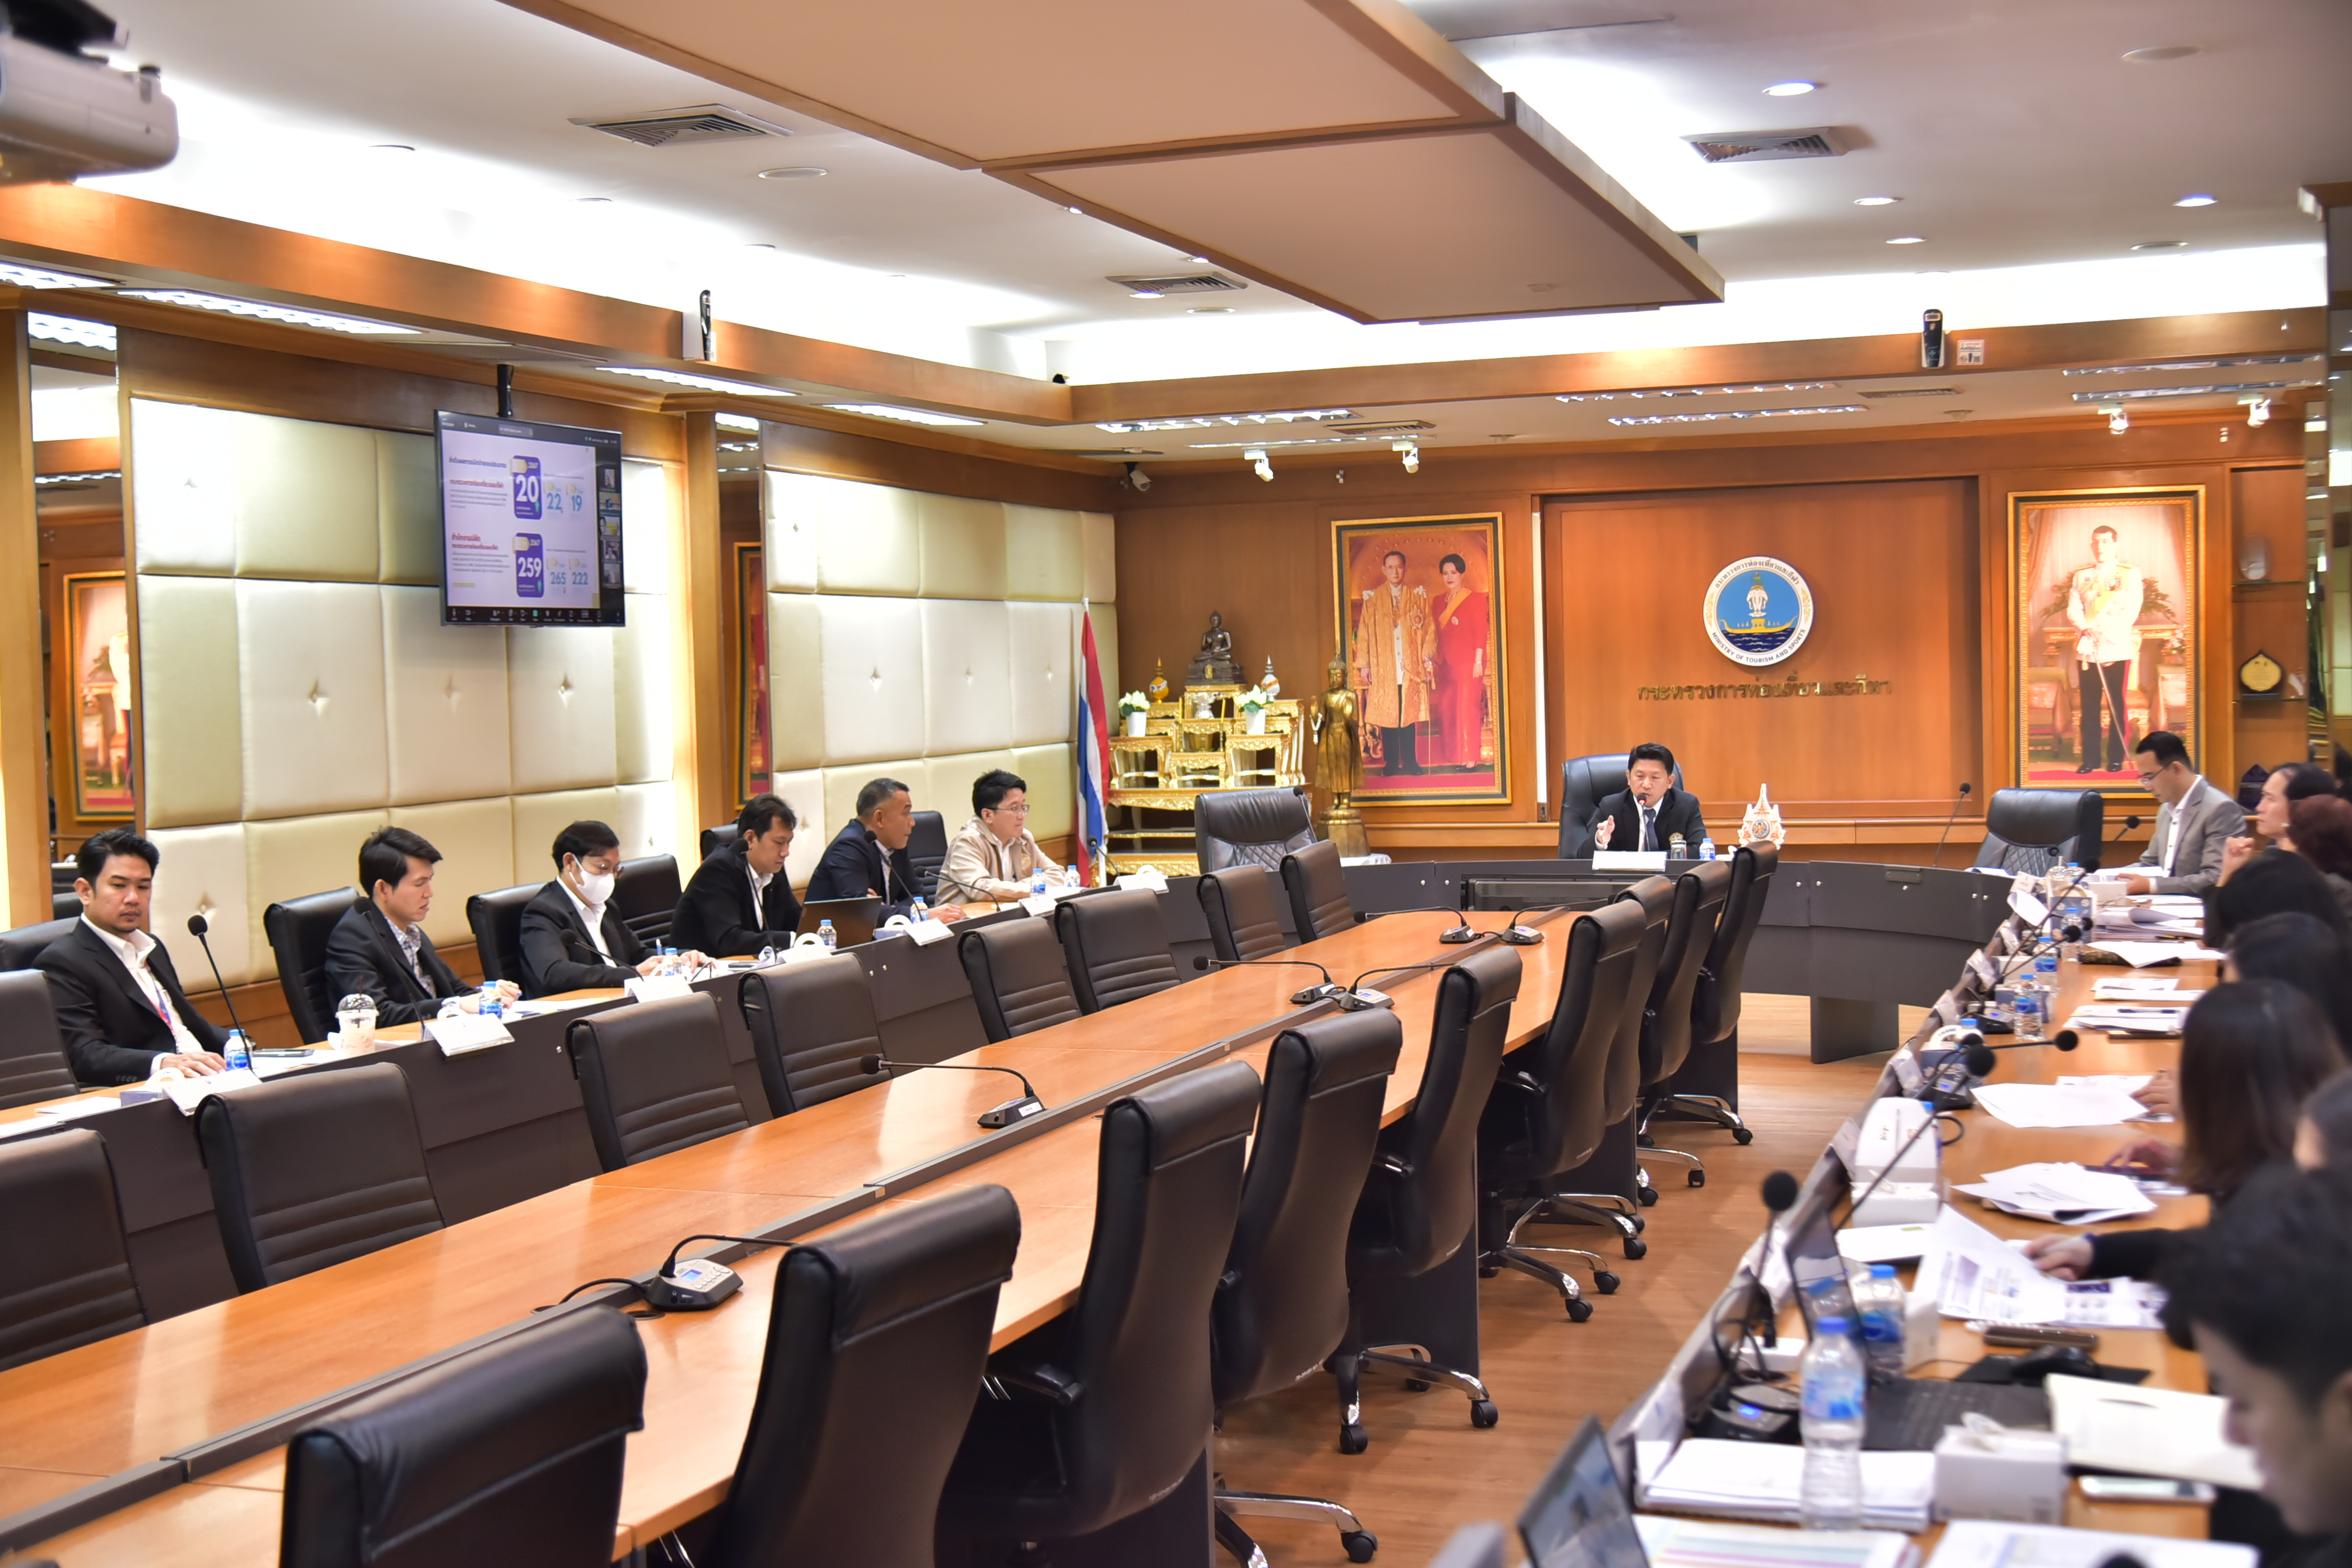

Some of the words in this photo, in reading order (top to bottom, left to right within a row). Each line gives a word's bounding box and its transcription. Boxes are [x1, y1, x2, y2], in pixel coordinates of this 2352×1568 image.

[516, 474, 539, 503] 20
[547, 492, 562, 510] 22
[571, 495, 582, 511] 19
[518, 556, 542, 578] 259
[550, 571, 566, 585] 265
[1715, 559, 1800, 589] กระทรวงการท่องเที่ยวและกีฬา
[572, 572, 589, 585] 222
[1712, 632, 1734, 656] MINISTRY
[1775, 649, 1788, 659] AND
[1788, 629, 1806, 650] SPORTS
[1637, 671, 1892, 700] กระทรวงการท่องเที่ยวและกีฬา
